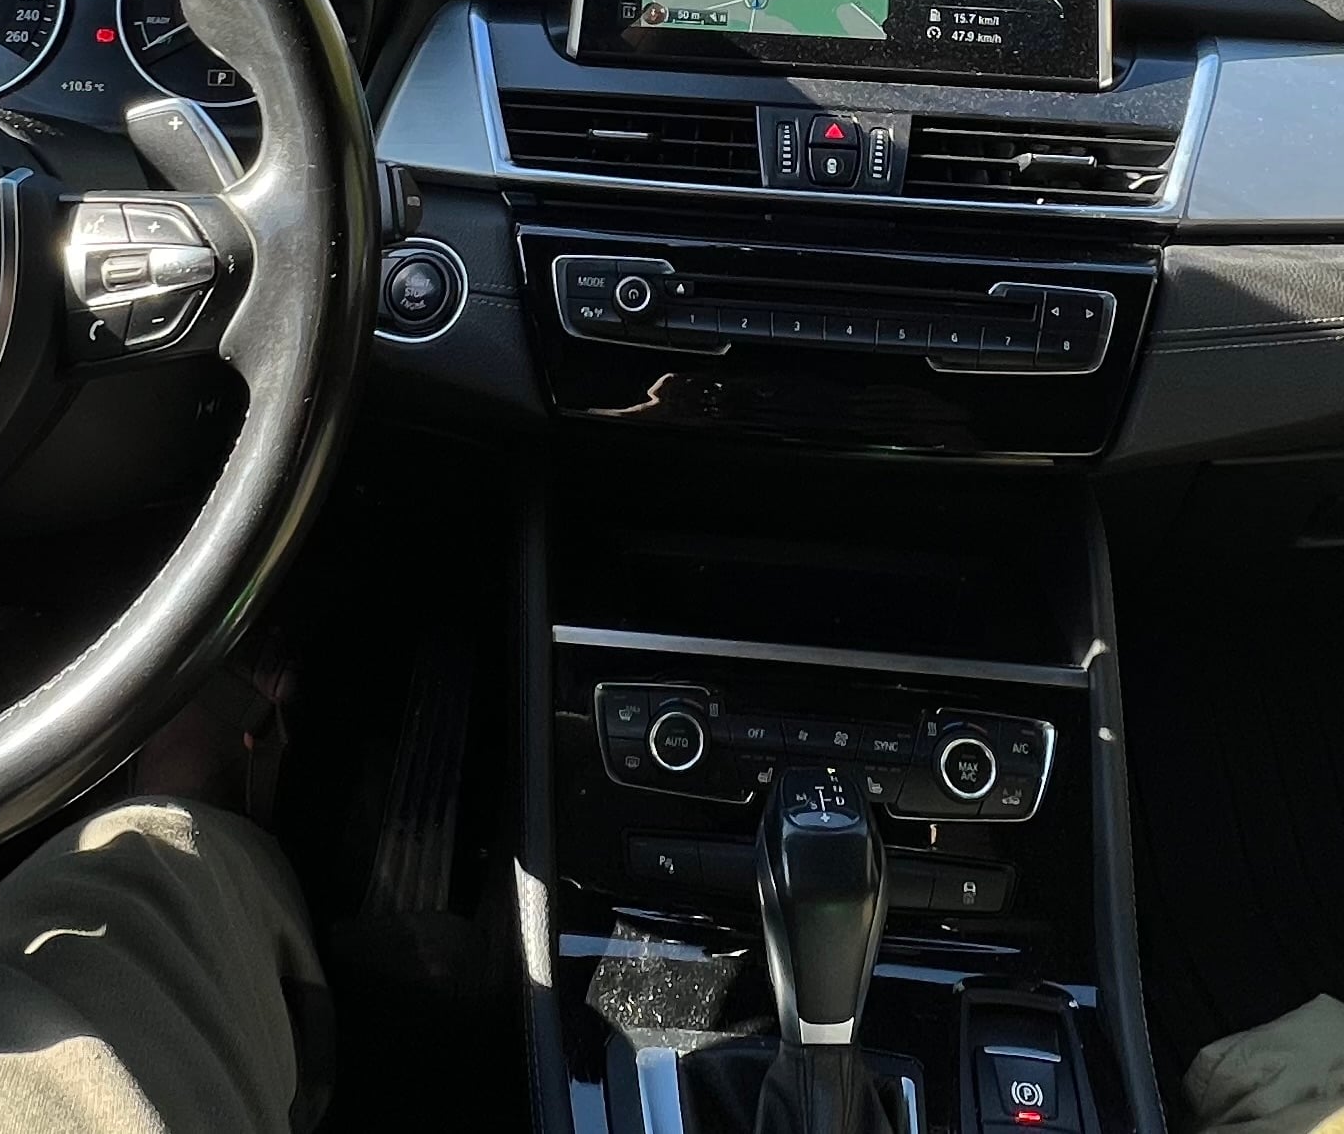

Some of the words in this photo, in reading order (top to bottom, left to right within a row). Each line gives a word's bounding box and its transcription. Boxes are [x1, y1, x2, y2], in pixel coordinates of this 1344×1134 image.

[16, 9, 40, 21] 240
[146, 16, 171, 24] READY
[677, 9, 690, 20] 50
[691, 12, 700, 20] m
[953, 12, 977, 24] 15.7
[978, 15, 1000, 26] km/l
[5, 31, 29, 43] 260
[951, 30, 975, 42] 47.9
[977, 33, 1002, 44] km/h
[217, 72, 227, 85] P
[577, 276, 606, 288] MODE
[747, 728, 766, 739] OFF
[664, 736, 689, 748] AUTO
[873, 740, 899, 753] SYNC
[1012, 742, 1030, 755] A/C
[958, 761, 979, 772] MAX
[960, 771, 977, 783] A/C
